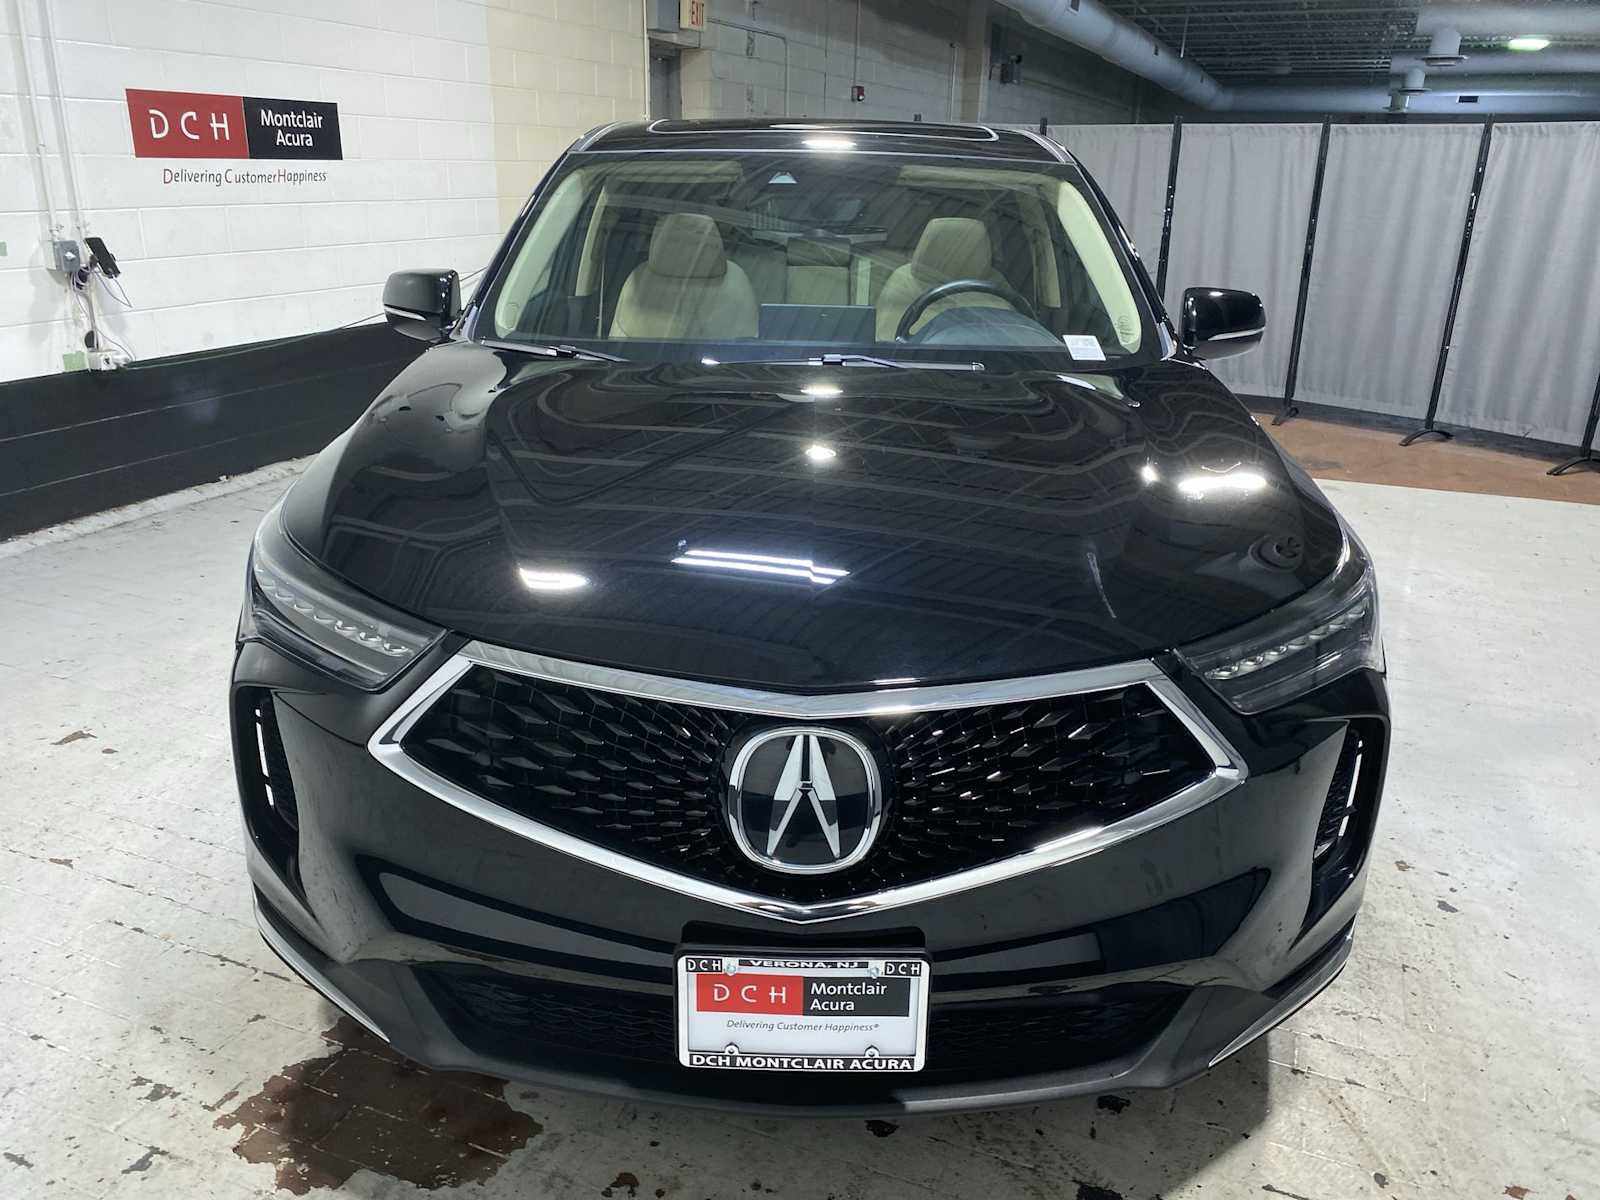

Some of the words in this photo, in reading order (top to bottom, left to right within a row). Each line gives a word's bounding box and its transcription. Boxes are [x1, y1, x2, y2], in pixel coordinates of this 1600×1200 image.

[691, 0, 704, 25] EXIT
[260, 109, 324, 129] Montclair
[276, 129, 314, 147] Acura
[163, 168, 222, 187] Delivering
[277, 169, 328, 186] Happiness
[687, 958, 722, 971] DCH
[749, 959, 831, 968] VERONA,
[837, 961, 859, 969] NJ
[886, 961, 921, 975] DCH
[810, 982, 888, 996] Montclair
[810, 998, 855, 1012] Acura
[726, 1019, 775, 1031] Delivering
[776, 1021, 823, 1032] Customer
[692, 1055, 731, 1067] DCH
[735, 1057, 845, 1069] MONTCLAIR
[849, 1059, 913, 1071] ACURA
